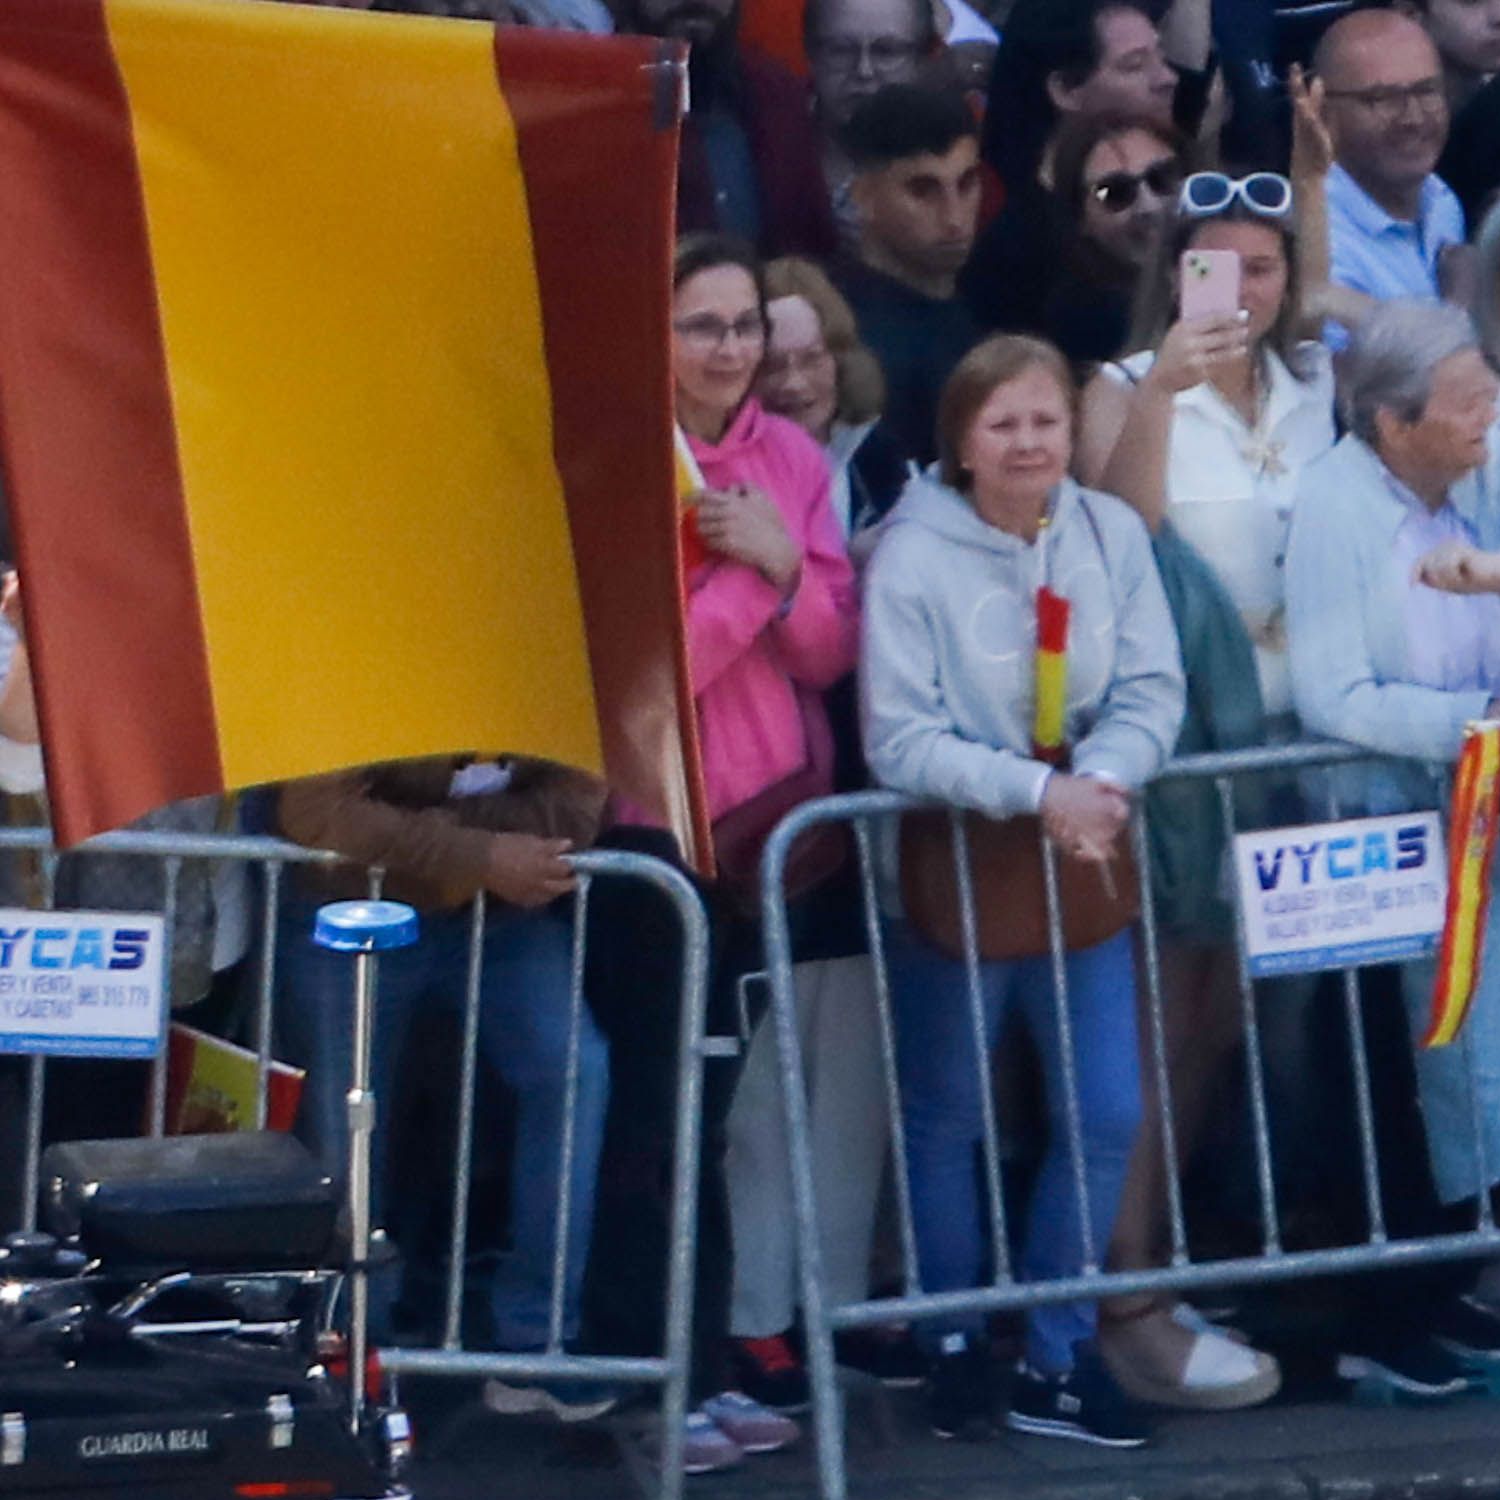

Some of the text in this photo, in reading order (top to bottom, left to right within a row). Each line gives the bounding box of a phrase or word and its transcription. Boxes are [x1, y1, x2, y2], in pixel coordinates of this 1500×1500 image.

[1254, 825, 1427, 890] VYCAS
[0, 928, 151, 970] YCAS
[79, 1428, 209, 1458] GUARDIA REAL
